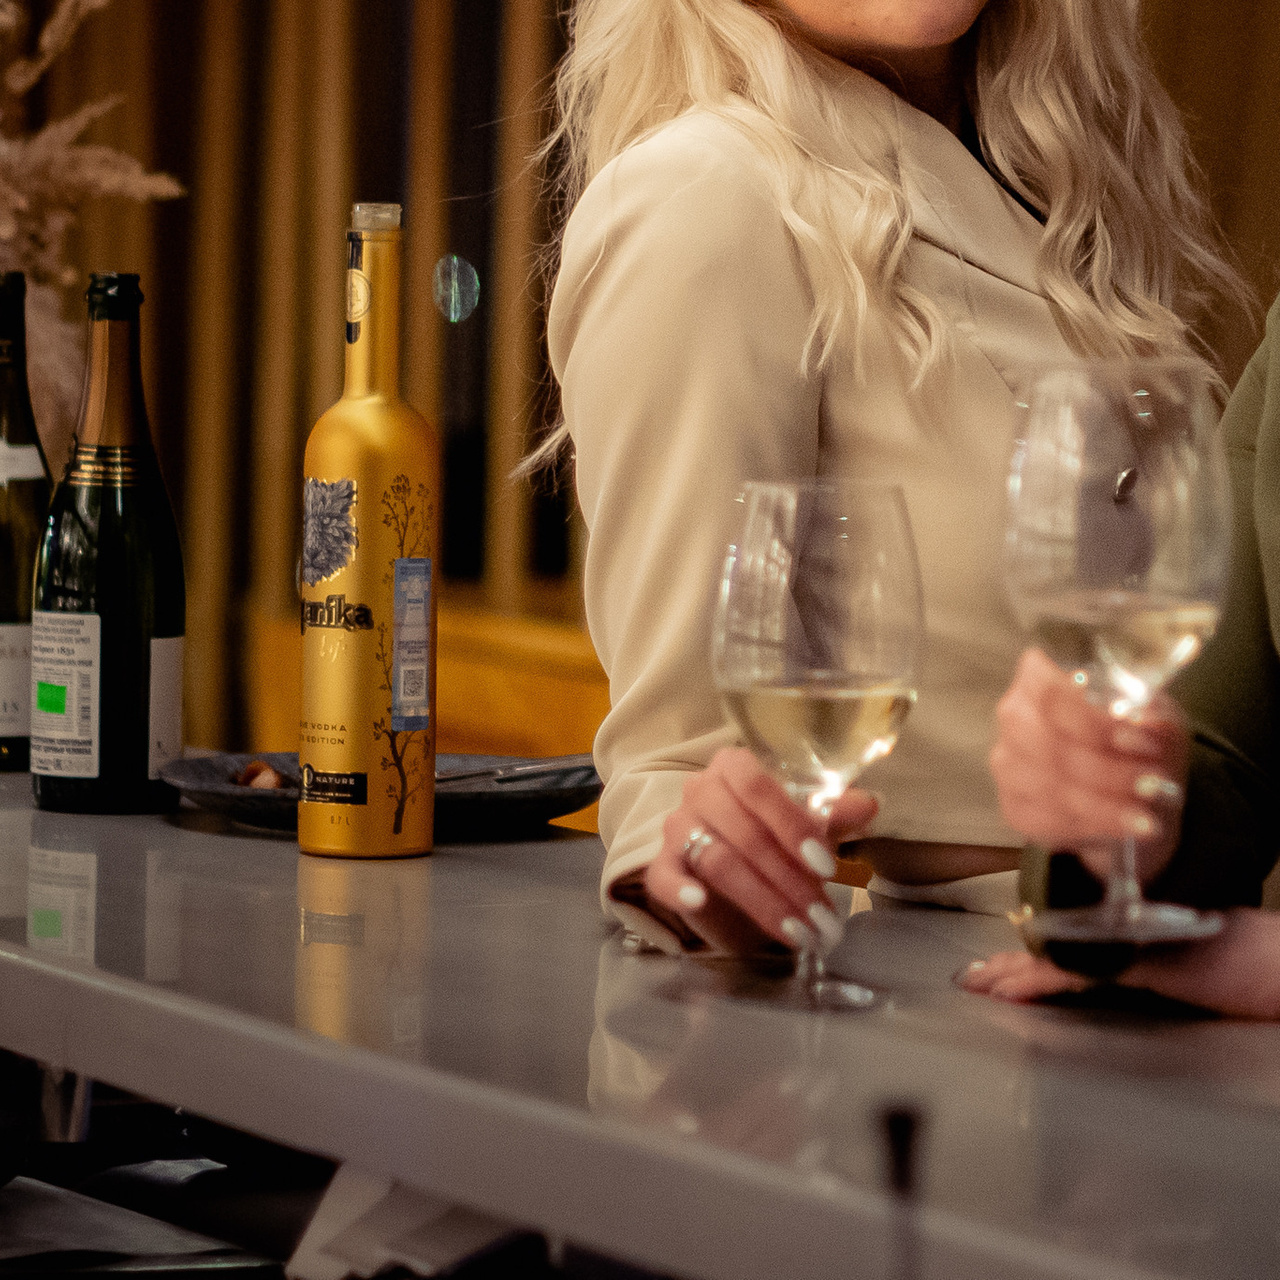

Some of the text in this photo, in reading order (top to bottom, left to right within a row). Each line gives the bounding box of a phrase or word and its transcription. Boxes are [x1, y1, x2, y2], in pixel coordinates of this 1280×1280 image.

[311, 723, 347, 732] VODKA
[306, 735, 345, 745] EDITION
[316, 776, 355, 786] NATURE
